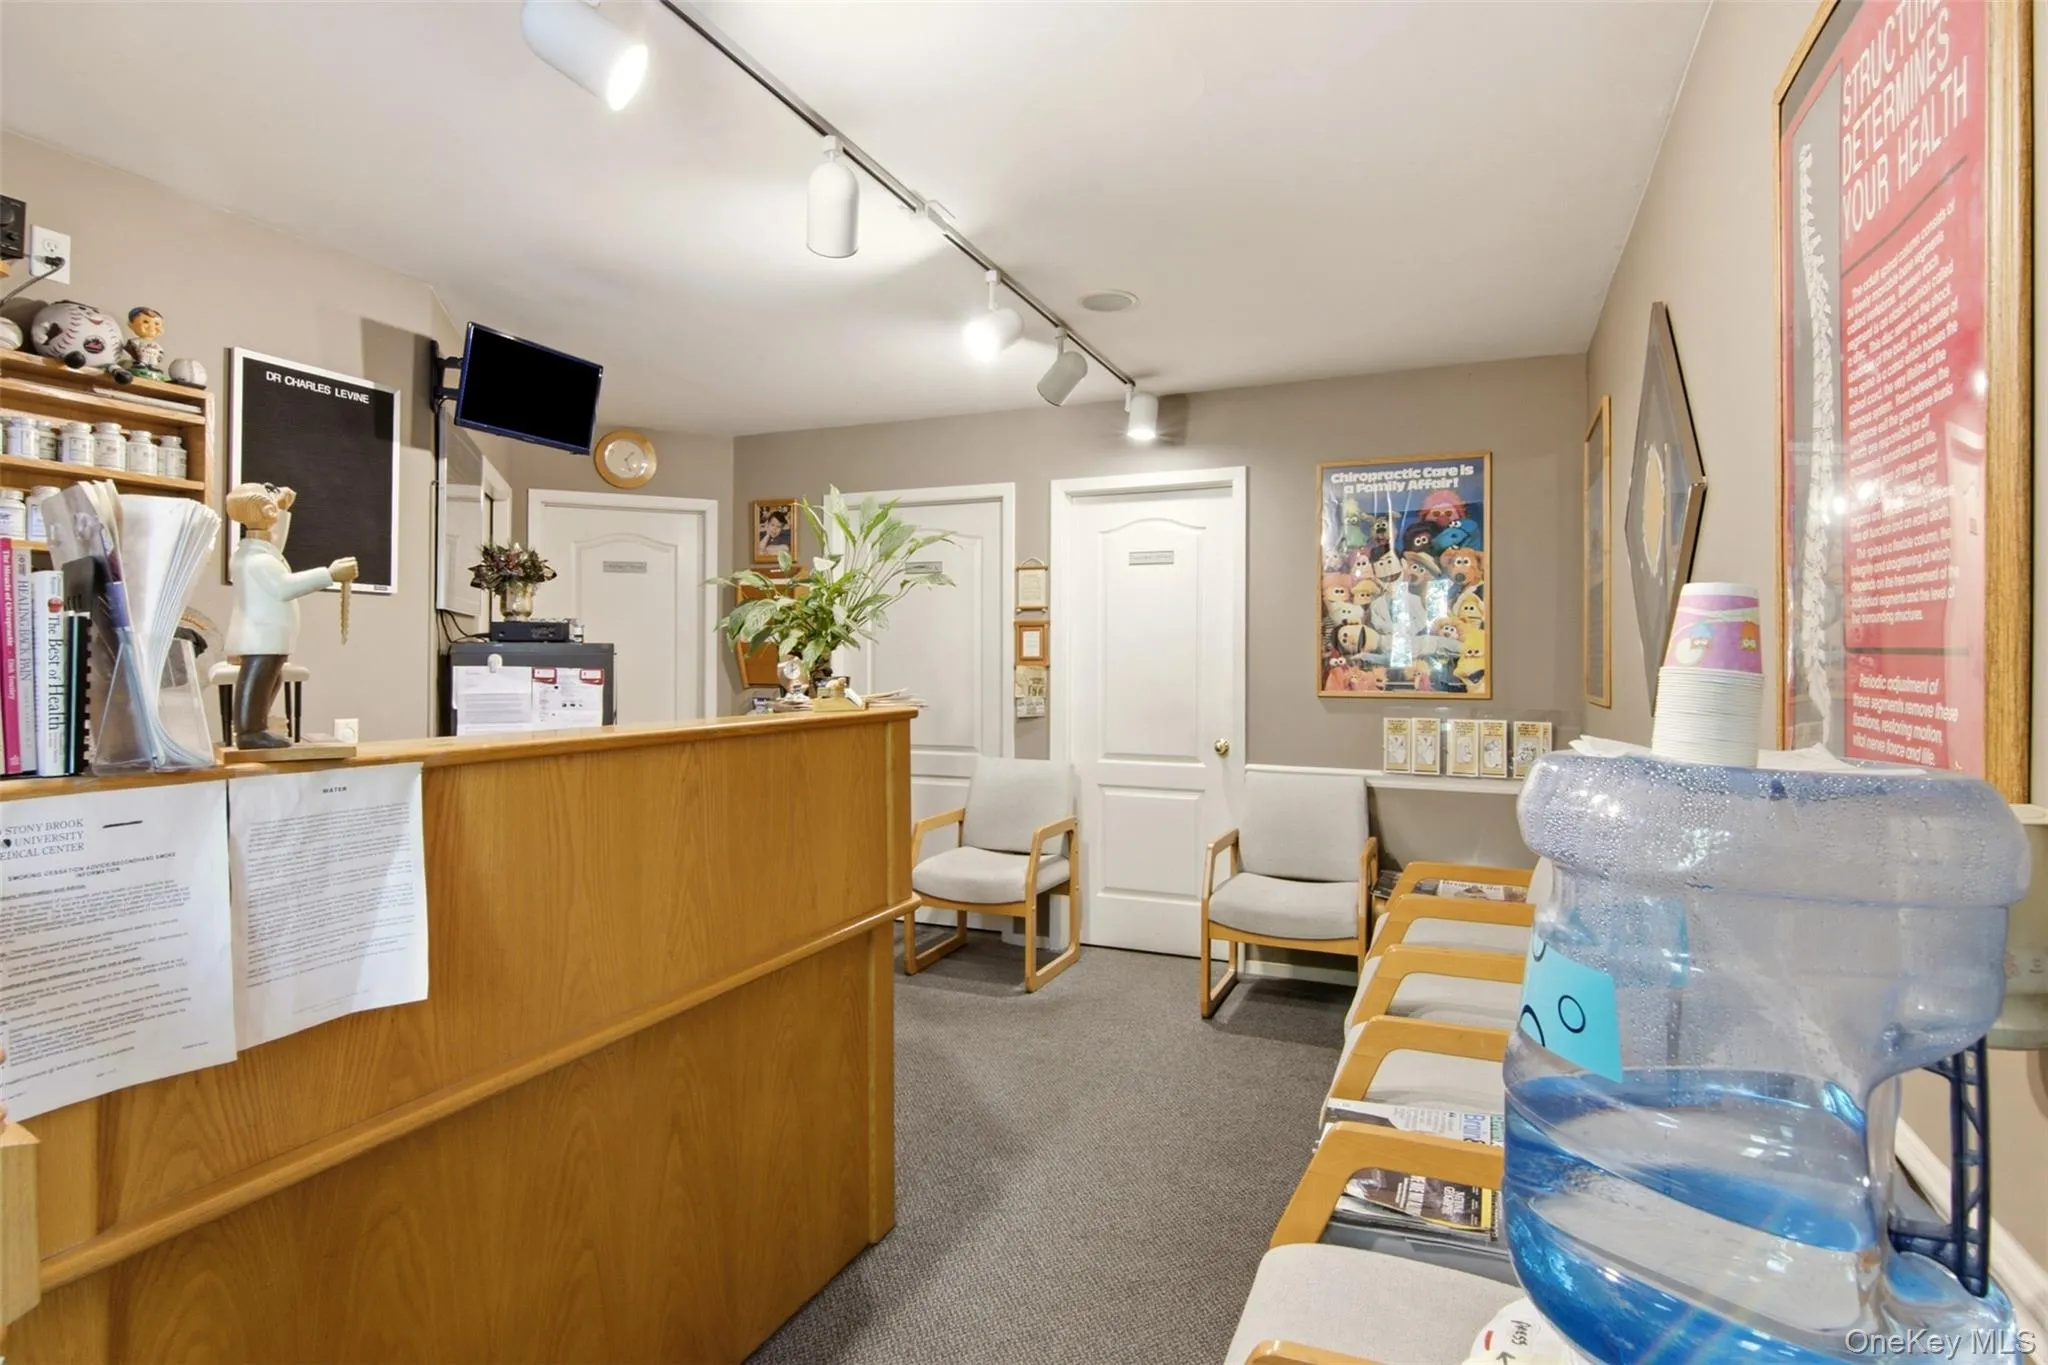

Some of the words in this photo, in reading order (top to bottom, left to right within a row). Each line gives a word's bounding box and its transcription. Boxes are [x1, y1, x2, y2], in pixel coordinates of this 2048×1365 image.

[1842, 0, 1941, 127] STRUCTUR
[1842, 8, 1949, 186] DETERMINES
[1842, 153, 1889, 241] YOUR
[1897, 55, 1968, 191] HEALTH
[265, 370, 281, 383] DR
[284, 375, 331, 395] CHARLES
[334, 387, 370, 404] LEVINE
[1331, 467, 1421, 483] Chiropractic
[1422, 465, 1458, 478] Care
[1459, 464, 1474, 476] is
[1343, 484, 1354, 494] a
[1356, 480, 1405, 493] Family
[1407, 477, 1459, 491] Affair!
[17, 579, 29, 628] HEALING
[48, 615, 60, 636] The
[20, 629, 30, 657] BACK
[48, 639, 64, 667] Best
[20, 657, 31, 681] PAIN
[48, 671, 60, 680] of
[1859, 673, 1887, 690] Periodic
[1886, 675, 1929, 695] adjustment
[1928, 677, 1940, 695] of
[48, 683, 66, 731] Health
[1852, 692, 1871, 709] these
[1870, 696, 1904, 714] segments
[1904, 701, 1934, 718] remove
[1934, 702, 1959, 722] these
[1852, 732, 1866, 748] vital
[1865, 736, 1886, 753] nerve
[1885, 739, 1905, 758] force
[1905, 746, 1922, 762] and
[322, 786, 348, 794] WATER
[5, 823, 44, 836] STONY
[45, 818, 84, 832] BROOK
[14, 830, 85, 847] UNIVERSITY
[0, 847, 41, 861] EDICAL
[41, 842, 85, 858] CENTER
[7, 872, 42, 882] SMOKING
[44, 866, 85, 877] CESSATION
